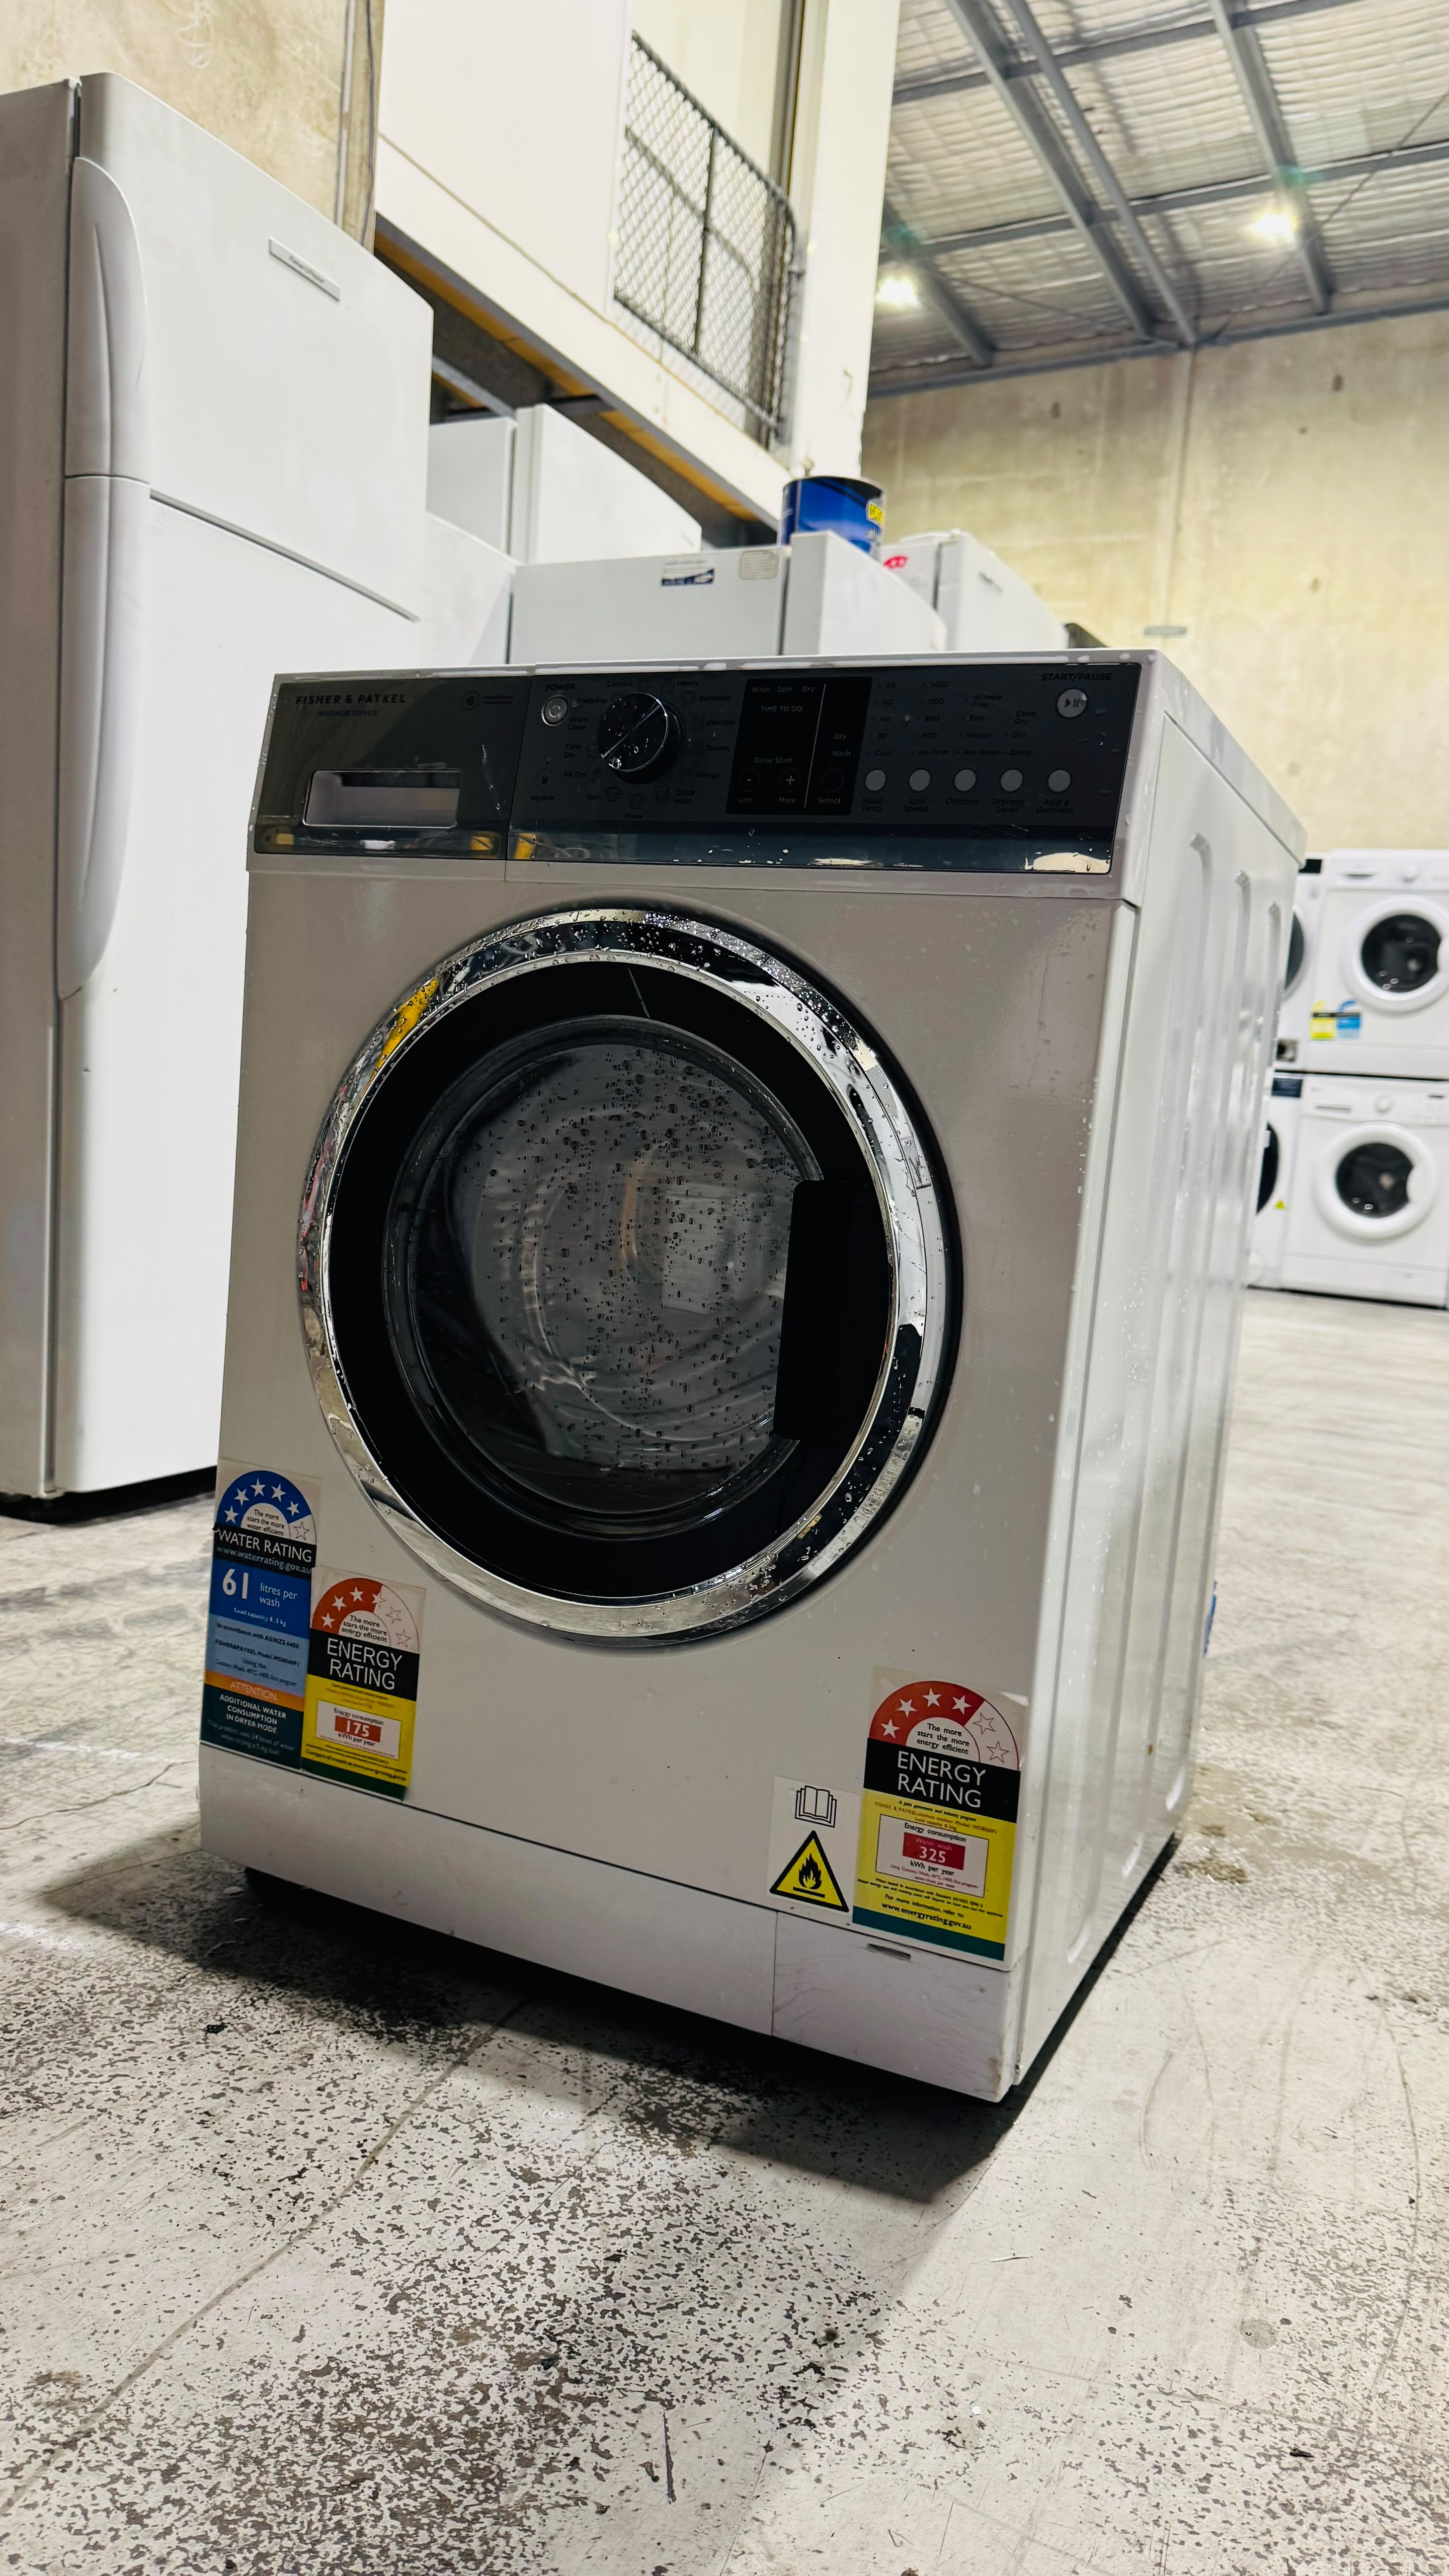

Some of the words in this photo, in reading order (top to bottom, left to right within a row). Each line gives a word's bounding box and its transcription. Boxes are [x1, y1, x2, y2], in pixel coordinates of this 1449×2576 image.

[1041, 673, 1112, 681] START/PAUSE
[296, 695, 341, 704] FISHER
[345, 695, 353, 704] &
[358, 694, 406, 704] PAYKEL
[946, 797, 978, 806] Options
[263, 1525, 283, 1536] efficient
[217, 1528, 260, 1550] WATER
[264, 1540, 311, 1562] RATING
[216, 1545, 311, 1576] www.waterrating.gov.au
[222, 1567, 249, 1599] 61
[260, 1582, 281, 1595] litres
[283, 1590, 297, 1602] per
[259, 1594, 280, 1607] wash
[350, 1615, 361, 1623] The
[342, 1628, 361, 1637] energy
[363, 1631, 387, 1642] efficient
[327, 1637, 402, 1672] ENERGY
[330, 1658, 395, 1691] RATING
[230, 1680, 277, 1701] ATTENTION
[219, 1694, 261, 1711] ADDITIONAL
[262, 1706, 286, 1719] WATER
[227, 1705, 277, 1725] CONSUMPTION
[235, 1716, 256, 1727] DRYER
[258, 1722, 277, 1734] MODE
[334, 1708, 350, 1717] Energy
[352, 1713, 383, 1726] consumption
[338, 1732, 352, 1740] kWh
[346, 1720, 370, 1738] 175
[927, 1723, 940, 1732] The
[944, 1728, 961, 1736] more
[917, 1739, 939, 1749] energy
[942, 1743, 969, 1754] efficient
[951, 1738, 969, 1746] more
[897, 1750, 986, 1787] ENERGY
[898, 1773, 982, 1808] RATING
[904, 1823, 924, 1834] Energy
[927, 1828, 966, 1843] consumption
[915, 1837, 934, 1846] Warm
[937, 1842, 952, 1851] wash
[919, 1846, 946, 1864] 325
[910, 1860, 925, 1869] kWh
[928, 1865, 938, 1873] per
[941, 1868, 954, 1877] year
[881, 1902, 971, 1931] www.energyrating.gov.au
